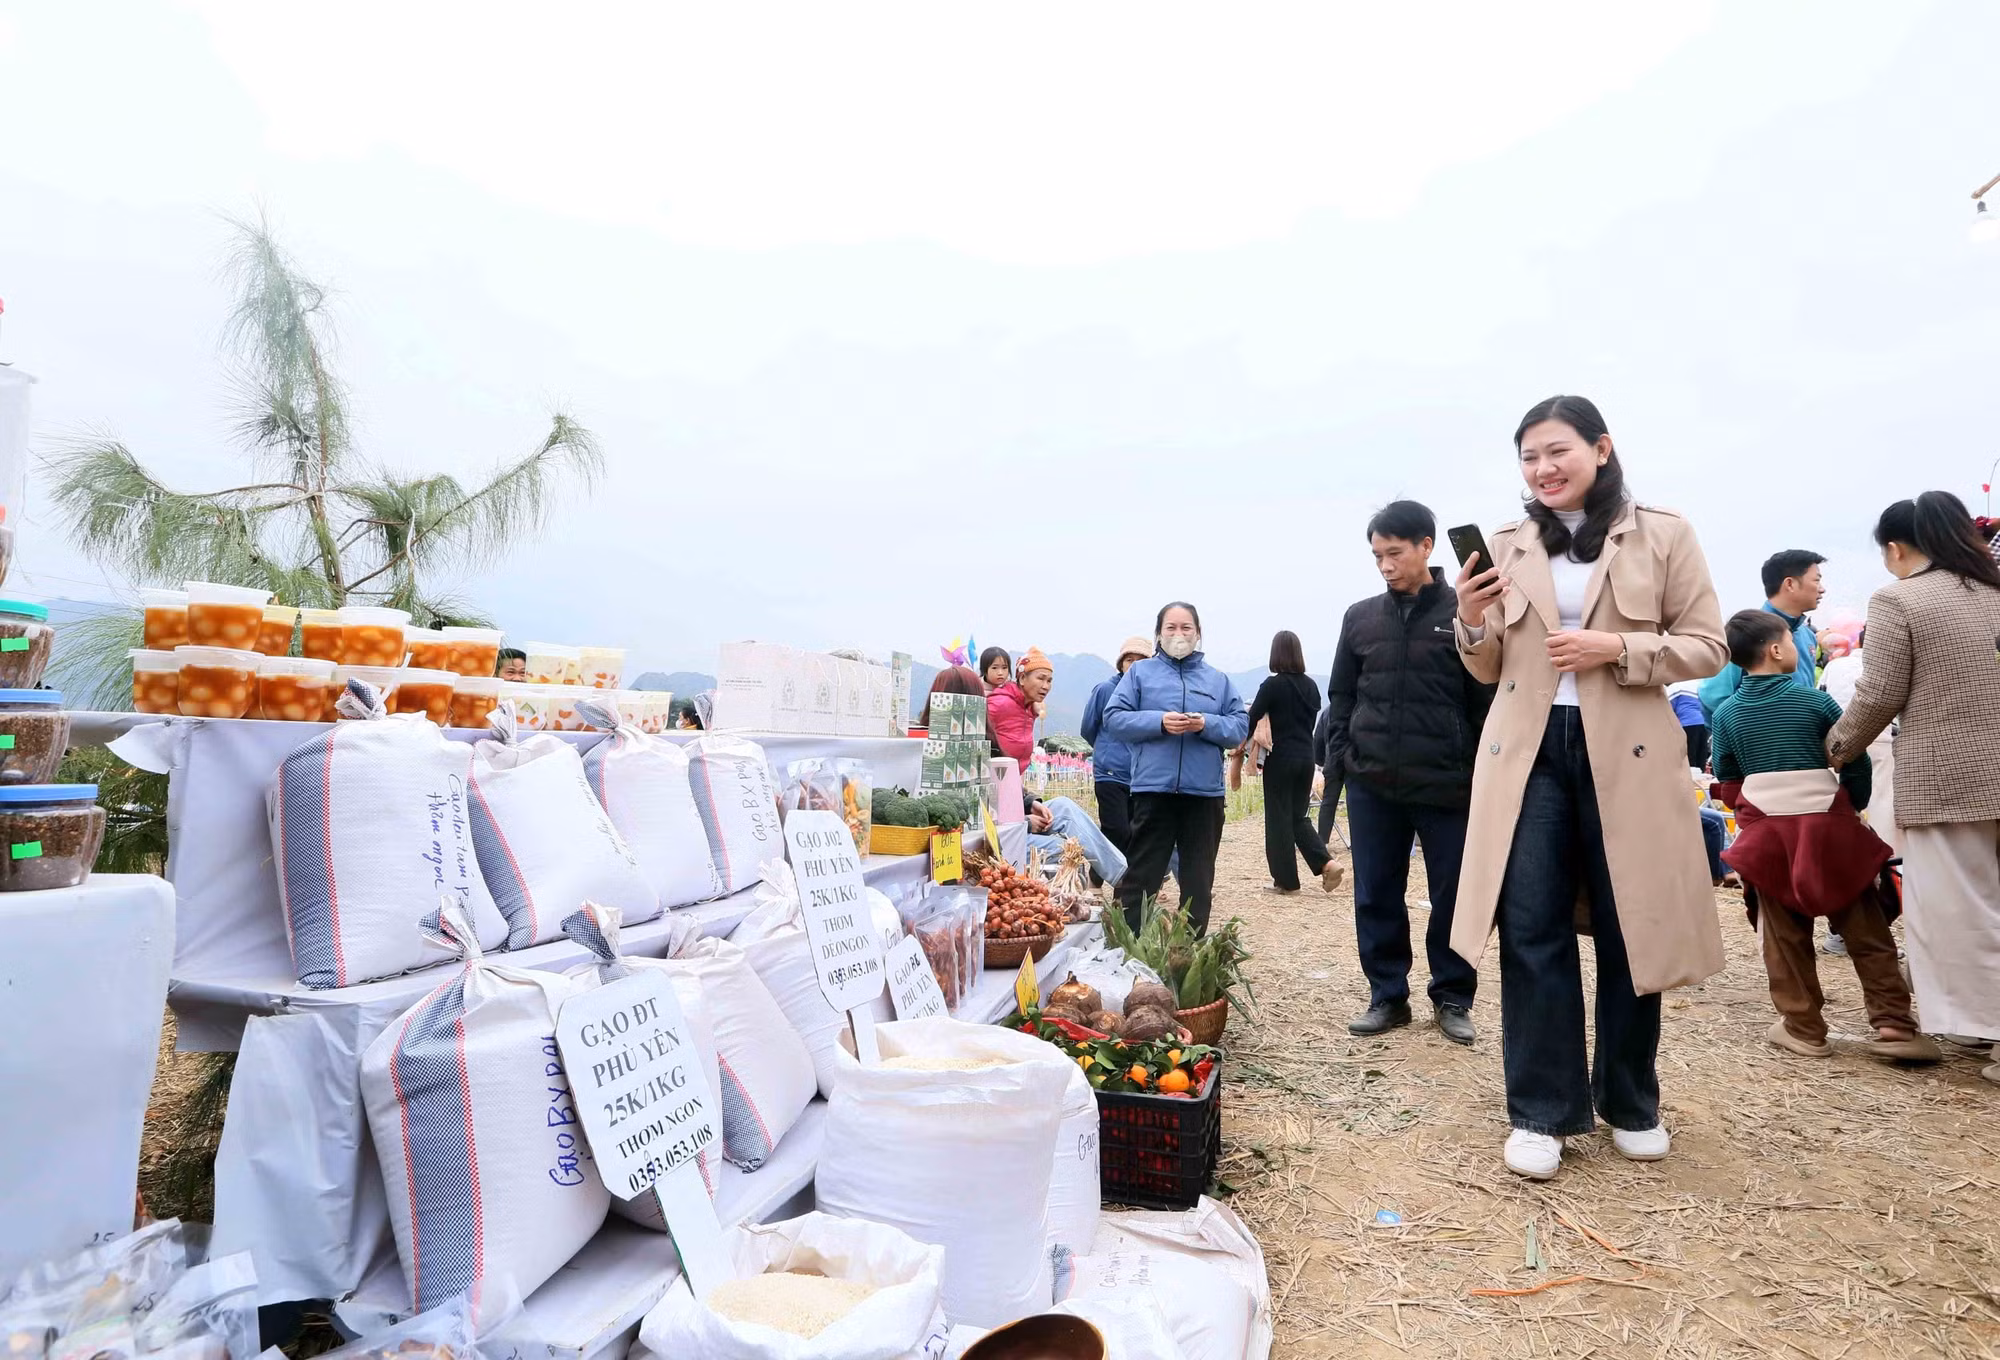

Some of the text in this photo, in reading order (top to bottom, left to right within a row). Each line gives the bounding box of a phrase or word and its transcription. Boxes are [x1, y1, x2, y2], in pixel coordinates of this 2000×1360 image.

[795, 830, 842, 853] GẠO J02
[804, 852, 854, 878] PHÙ YÊN
[810, 884, 858, 907] 25K/1KG
[894, 962, 911, 986] GẠO
[901, 971, 934, 1011] PHÙ YÊN
[580, 997, 659, 1048] GẠO ĐT
[592, 1026, 681, 1089] PHÙ YÊN
[603, 1065, 686, 1128] 25K/1KG
[615, 1095, 705, 1160] THƠM NGON
